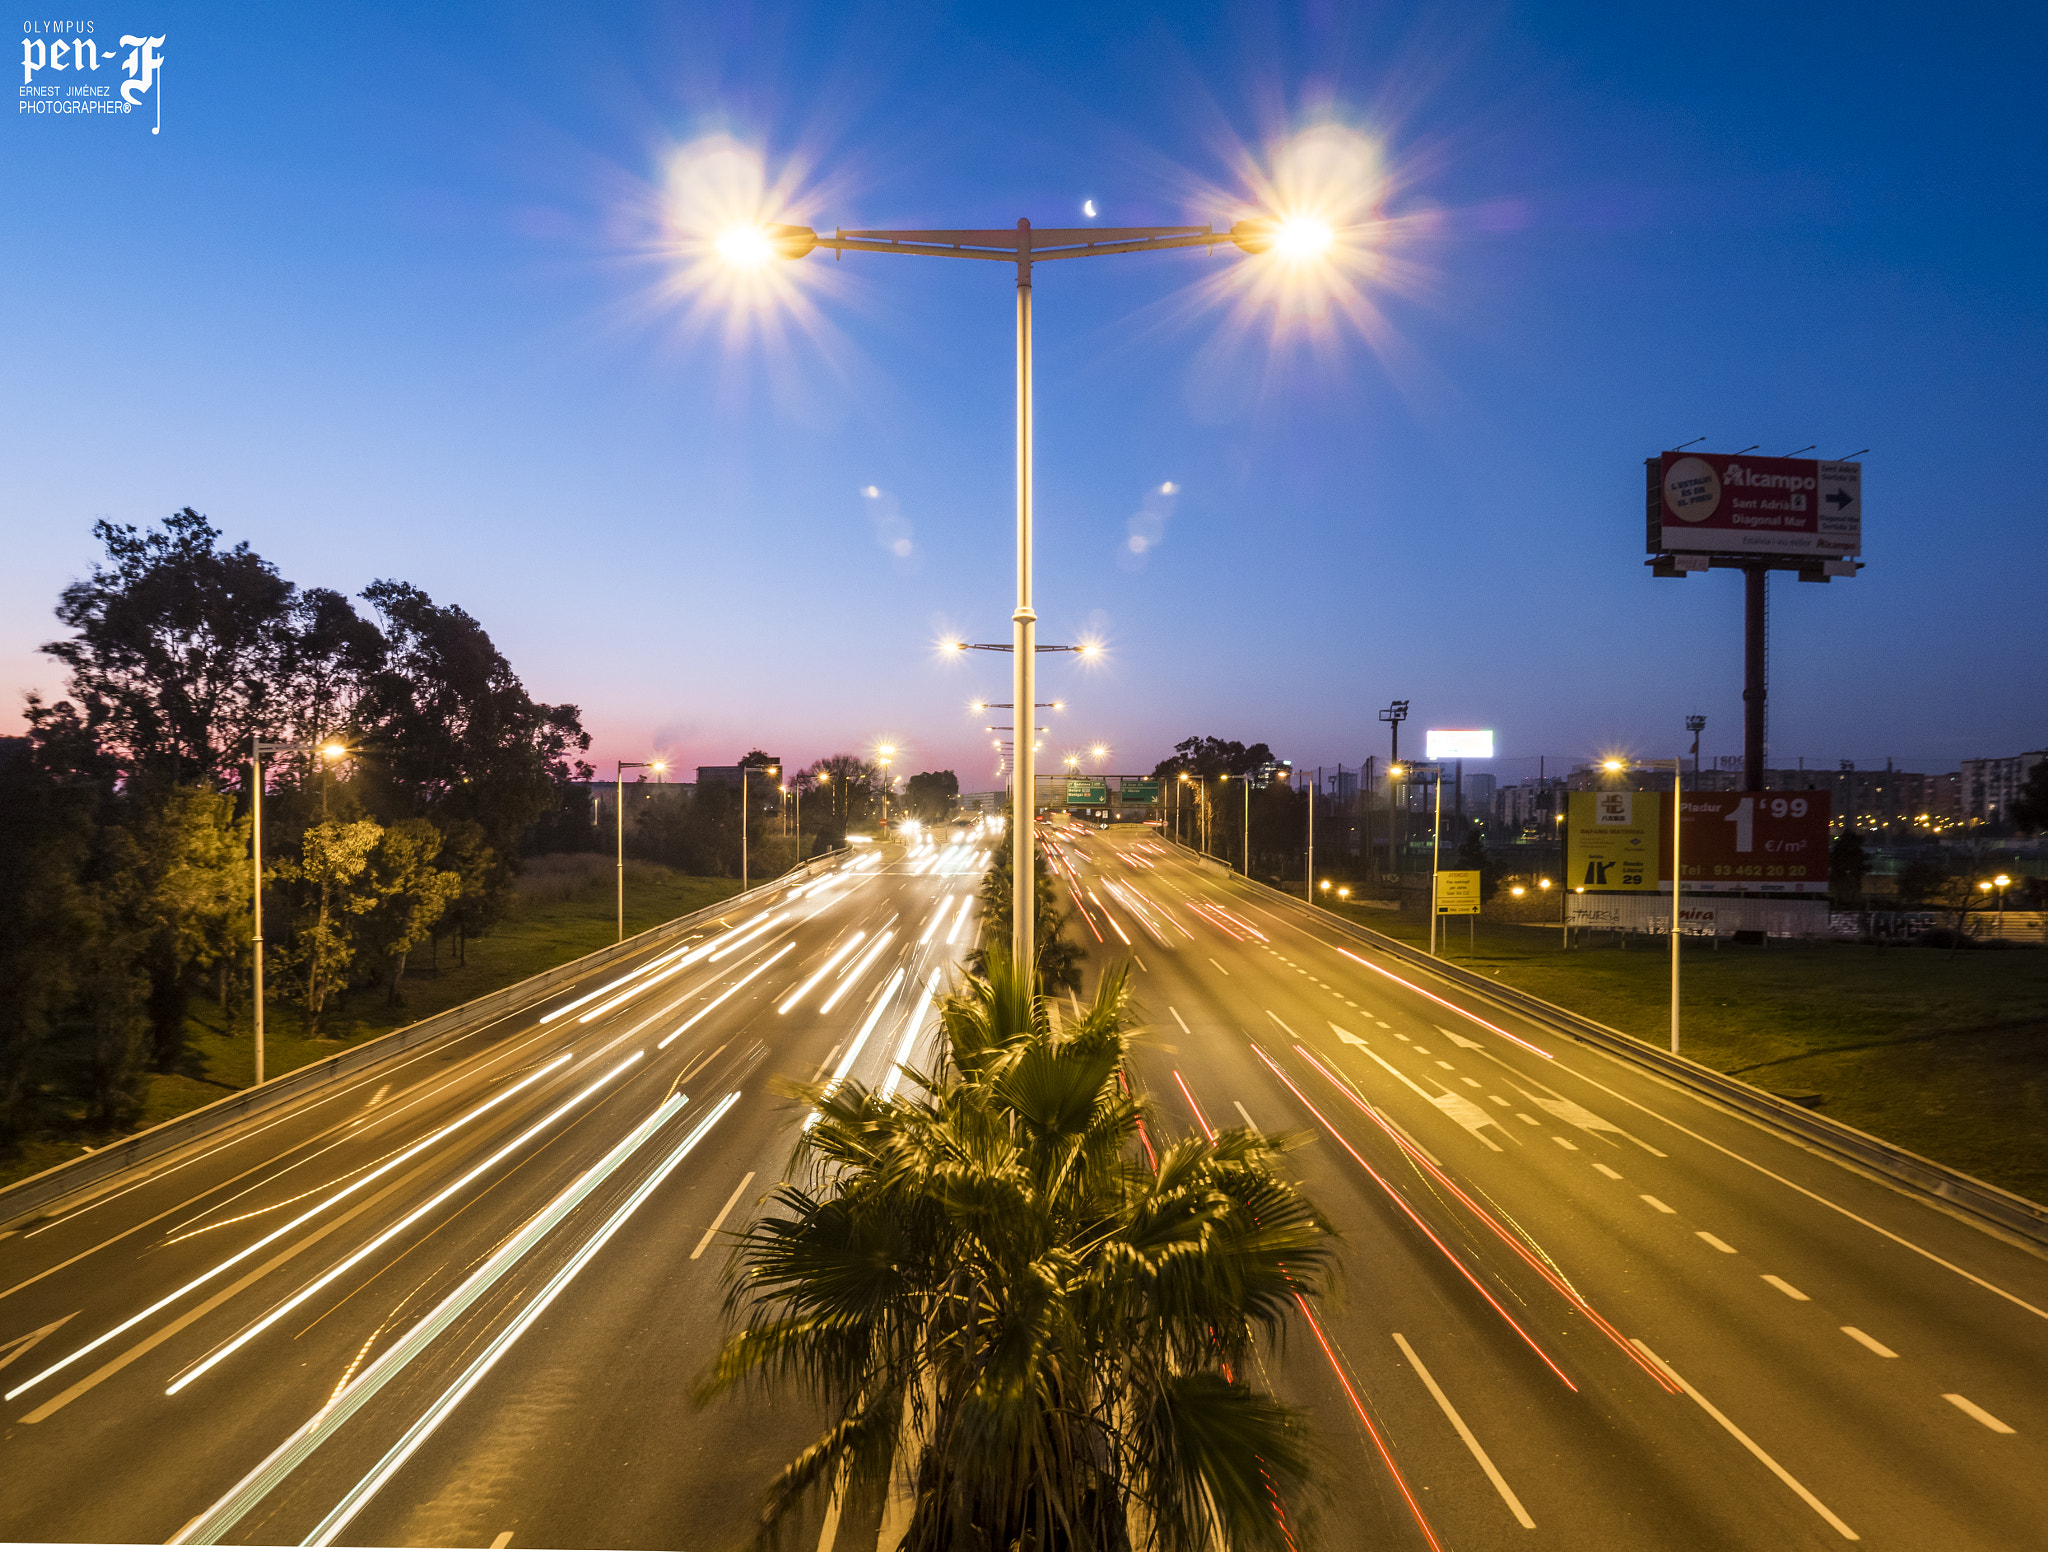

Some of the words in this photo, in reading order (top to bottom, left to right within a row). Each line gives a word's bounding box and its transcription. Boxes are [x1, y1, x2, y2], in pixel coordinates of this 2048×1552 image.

[1722, 464, 1816, 492] Alcampo
[1732, 498, 1757, 509] Sant
[1732, 513, 1782, 527] Diagonal
[1784, 516, 1807, 527] Mar
[1680, 802, 1722, 812] Pladur
[1713, 864, 1732, 876] 93
[1766, 864, 1784, 876] 20
[1789, 864, 1807, 876] 20
[1622, 875, 1643, 885] 29
